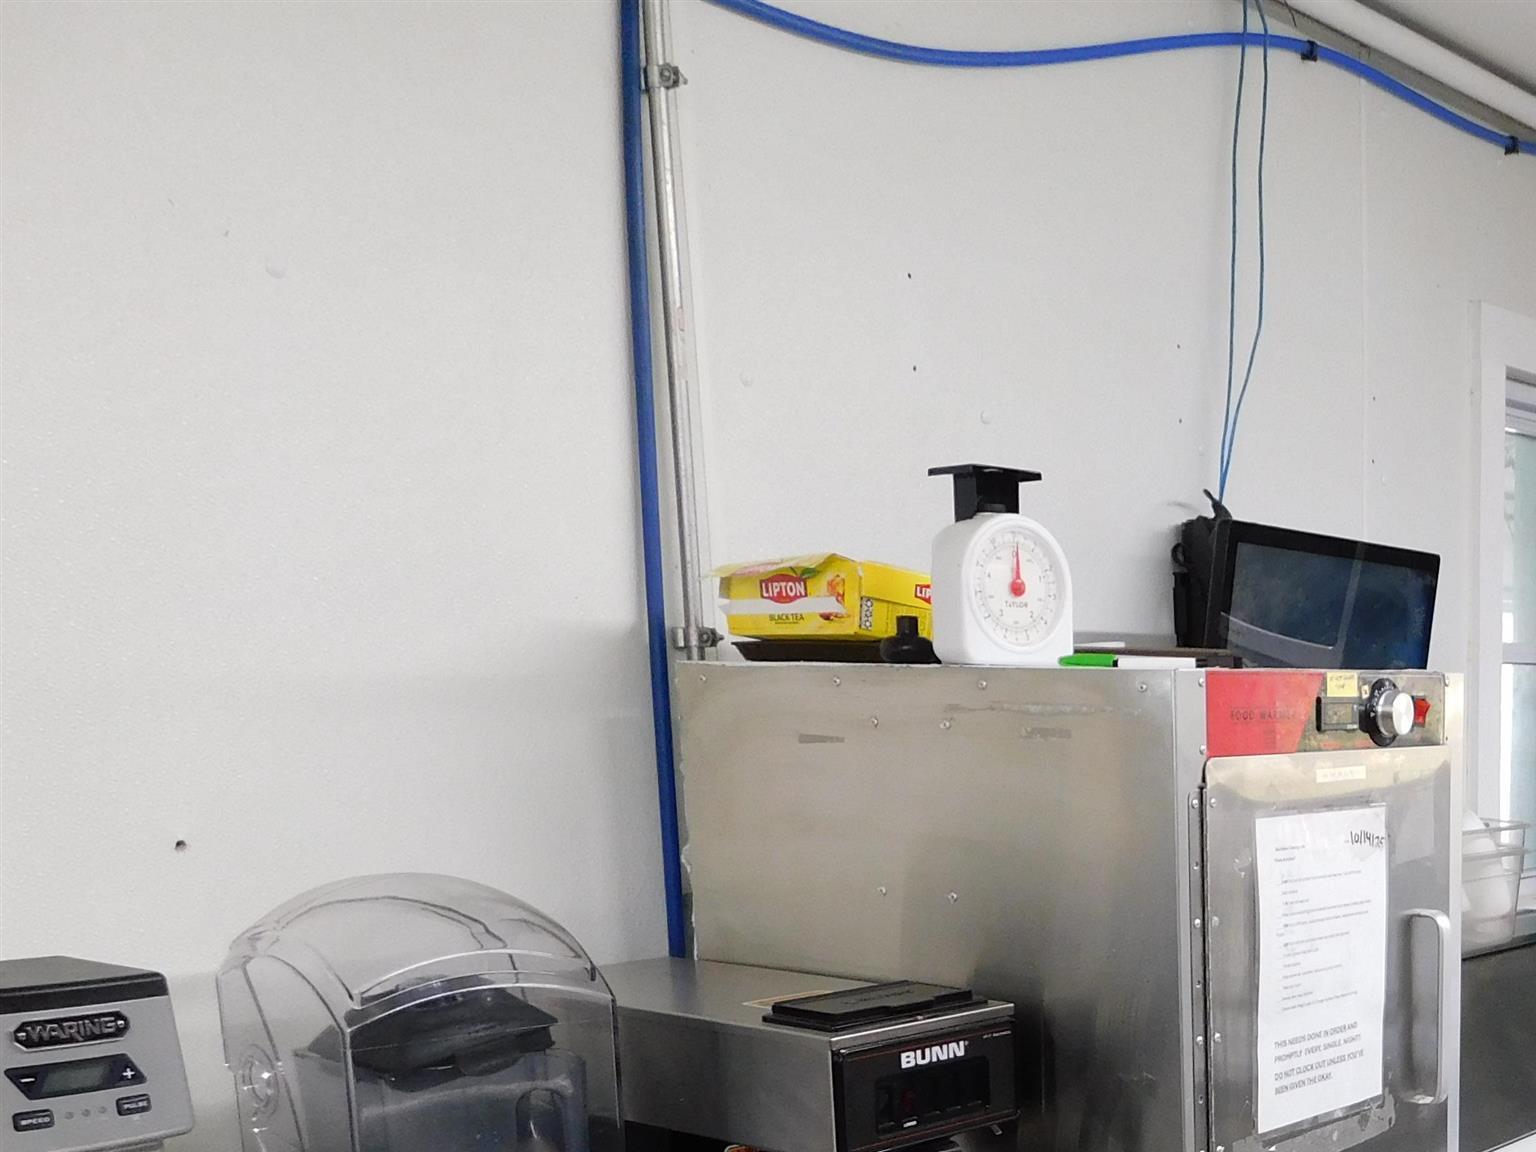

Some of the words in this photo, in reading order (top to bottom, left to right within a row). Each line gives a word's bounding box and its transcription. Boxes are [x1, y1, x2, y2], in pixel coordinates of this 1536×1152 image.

[761, 581, 805, 598] LIPTON
[917, 586, 932, 599] LIP
[1005, 601, 1028, 609] TAYLOR
[769, 614, 790, 622] BLACK
[791, 613, 805, 621] TEA
[25, 1017, 115, 1041] WARING
[900, 1040, 965, 1069] BUNN
[1296, 1063, 1314, 1075] CLOCK
